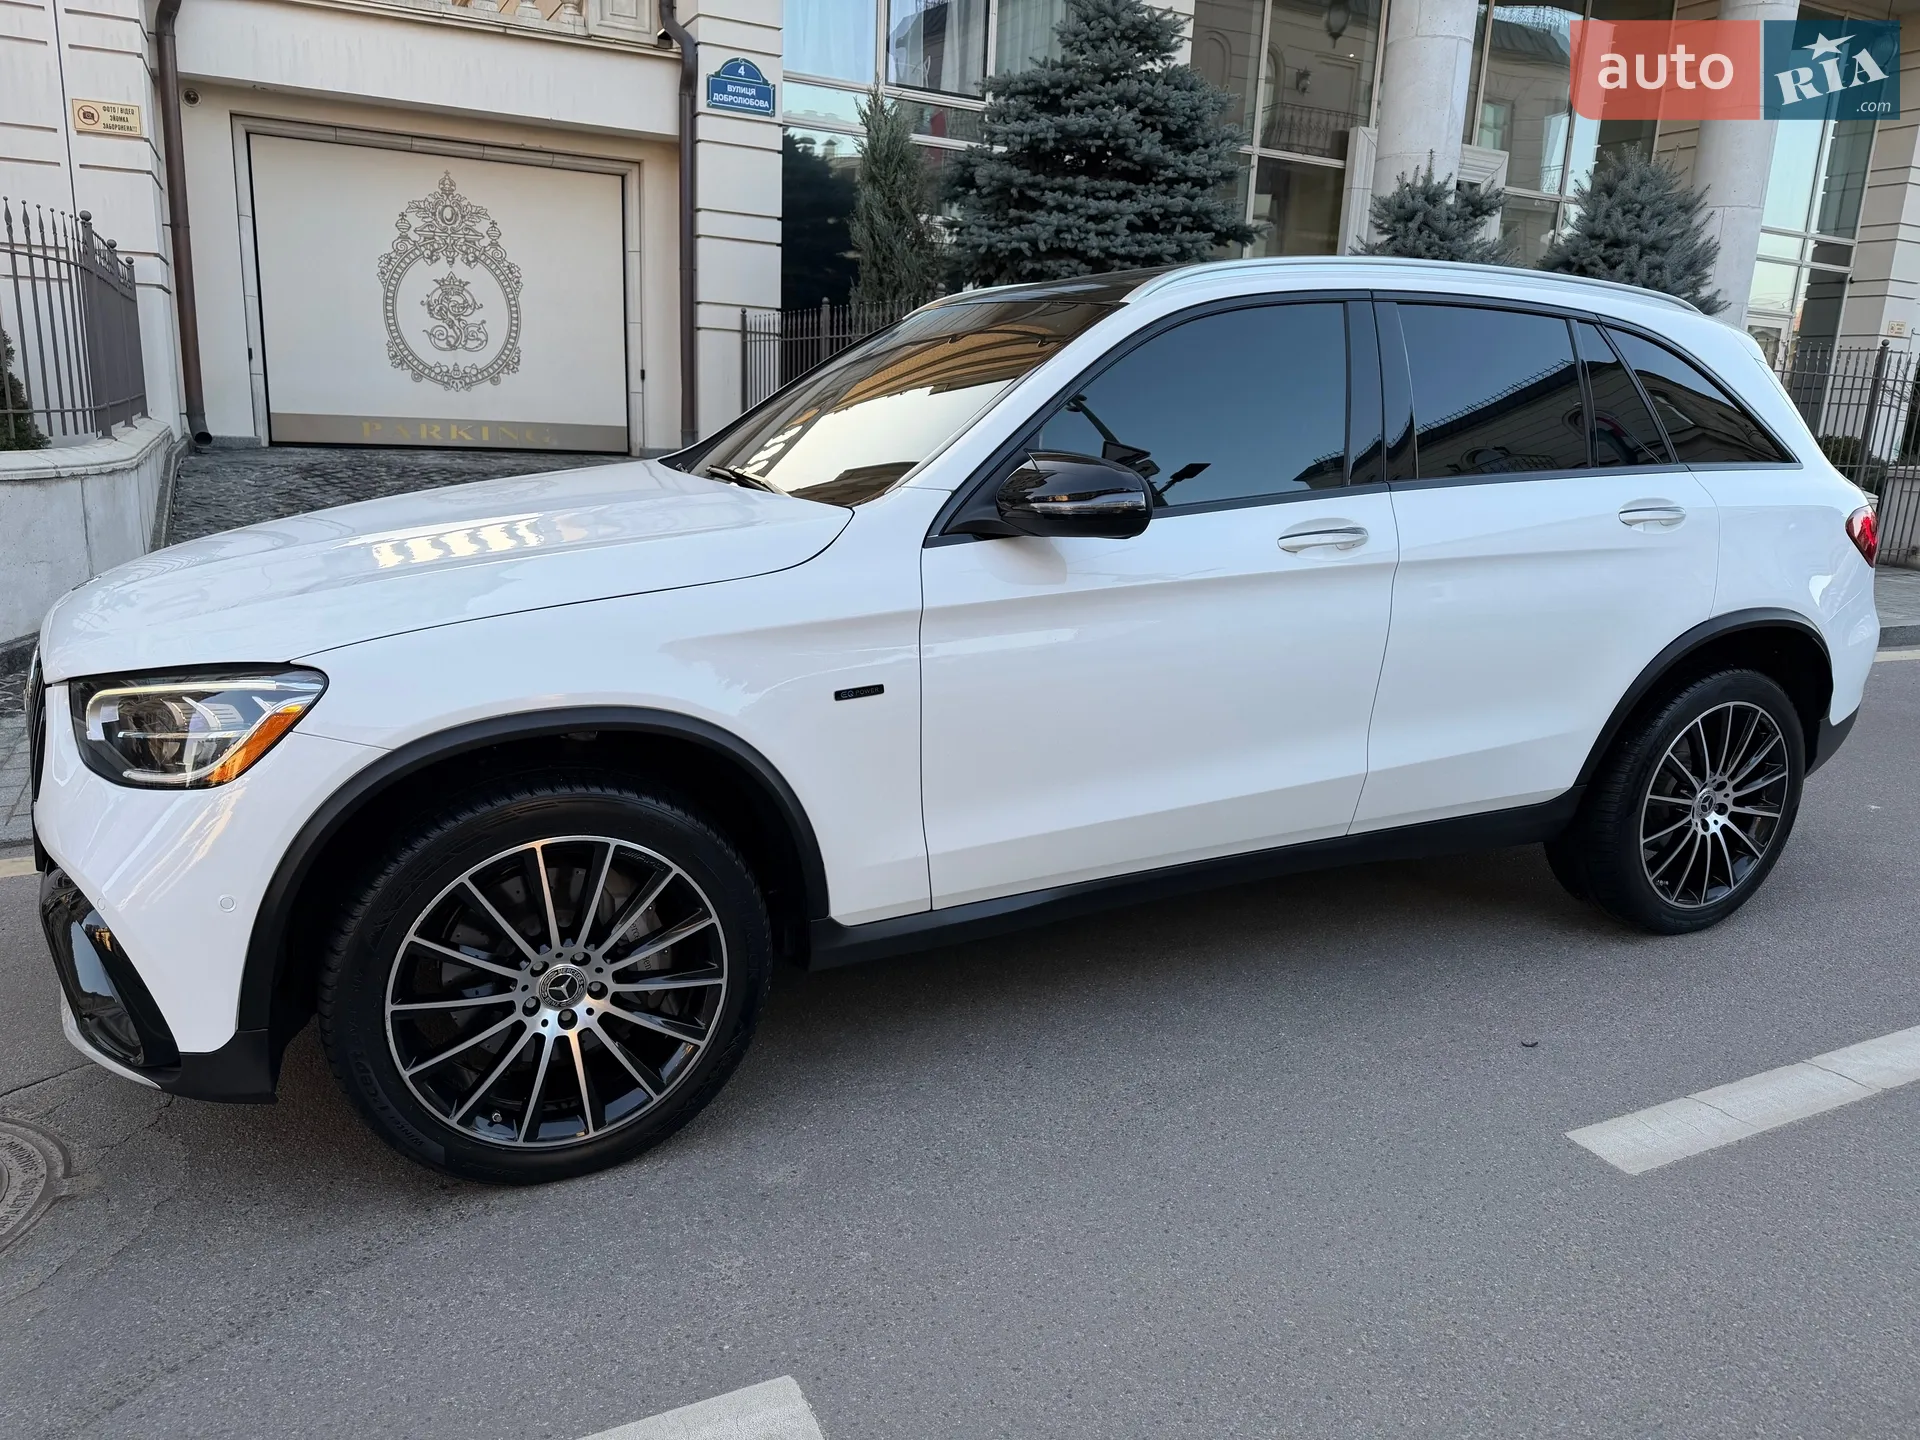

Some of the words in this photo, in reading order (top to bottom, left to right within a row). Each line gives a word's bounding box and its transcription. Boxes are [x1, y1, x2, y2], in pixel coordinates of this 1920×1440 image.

[738, 65, 745, 76] 4
[727, 84, 756, 96] ВУЛИЦЯ
[712, 92, 770, 108] ДОБРОЛЮБОВА
[361, 420, 556, 445] PARKING
